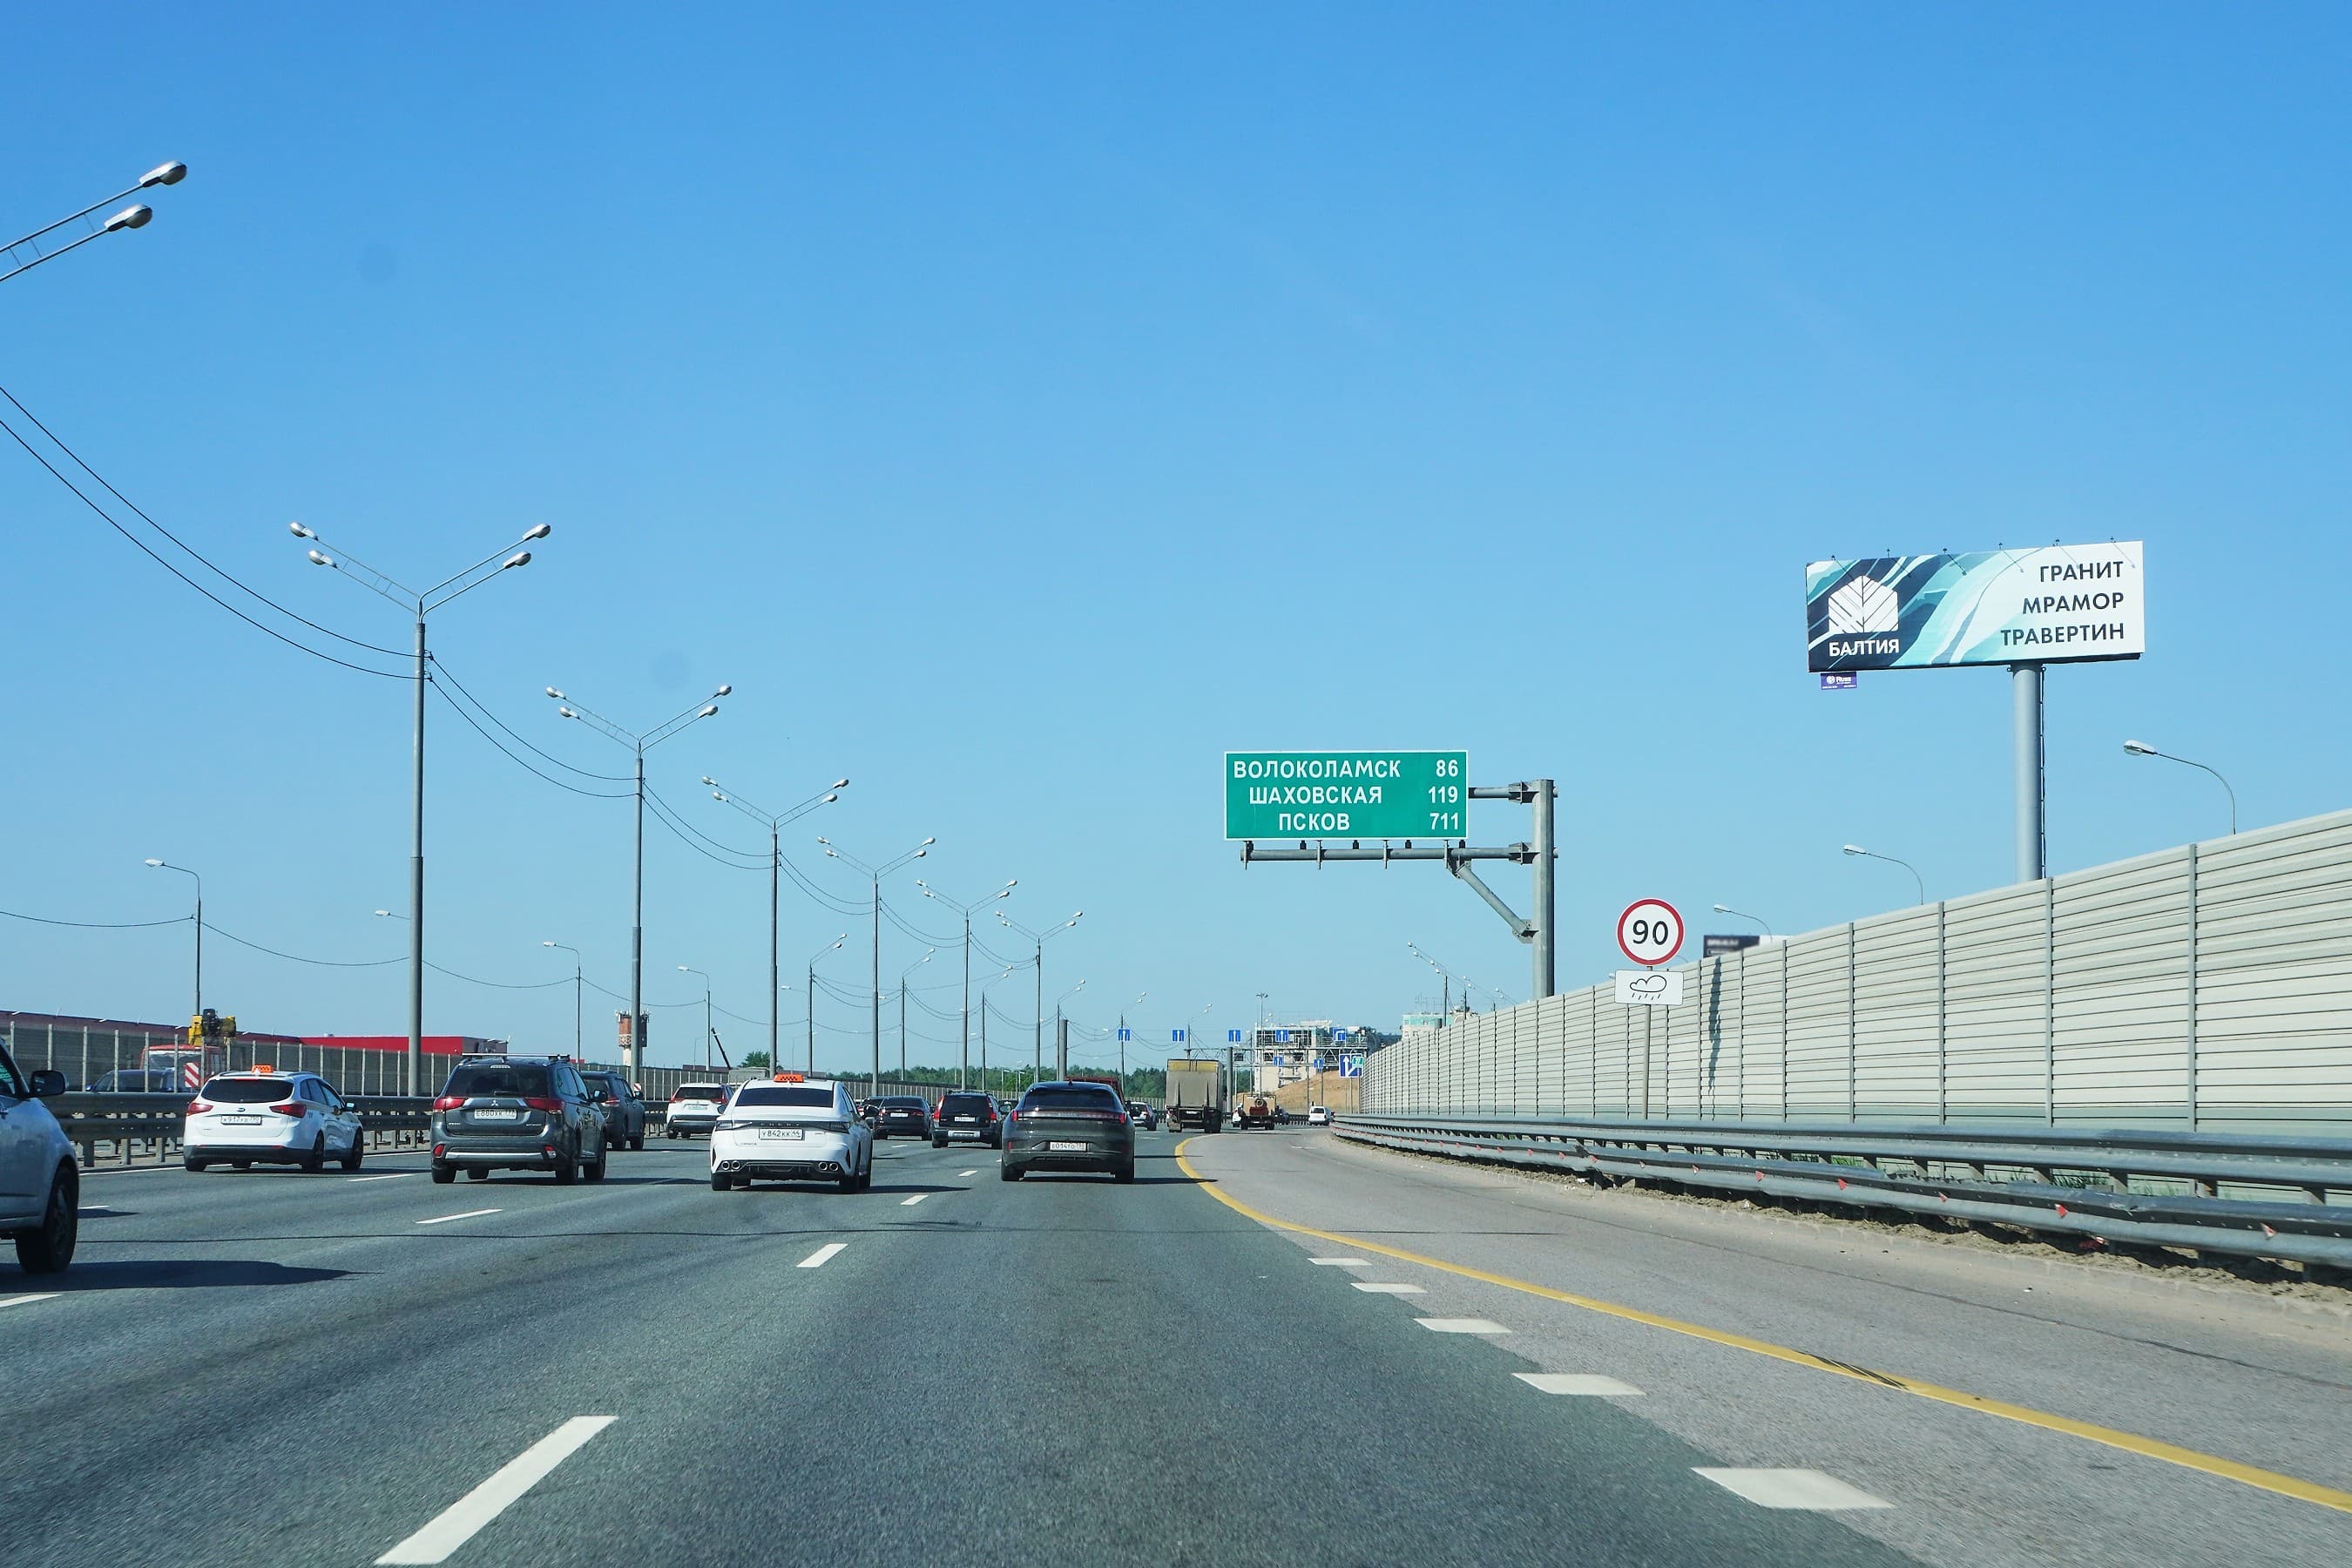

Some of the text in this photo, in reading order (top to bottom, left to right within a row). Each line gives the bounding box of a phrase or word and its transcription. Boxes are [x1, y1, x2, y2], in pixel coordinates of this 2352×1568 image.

[2039, 561, 2124, 583] ГРАНИТ
[2022, 592, 2125, 614] МРАМОР
[2000, 623, 2125, 646] ТРАВЕРТИН
[1828, 639, 1899, 657] БАЛТИЯ
[1233, 760, 1459, 779] ВОЛОКОЛАМСК 86
[1249, 786, 1458, 805] ШАХОВСКАЯ 119
[1279, 812, 1459, 831] ПСКОВ 711
[1632, 919, 1669, 945] 90
